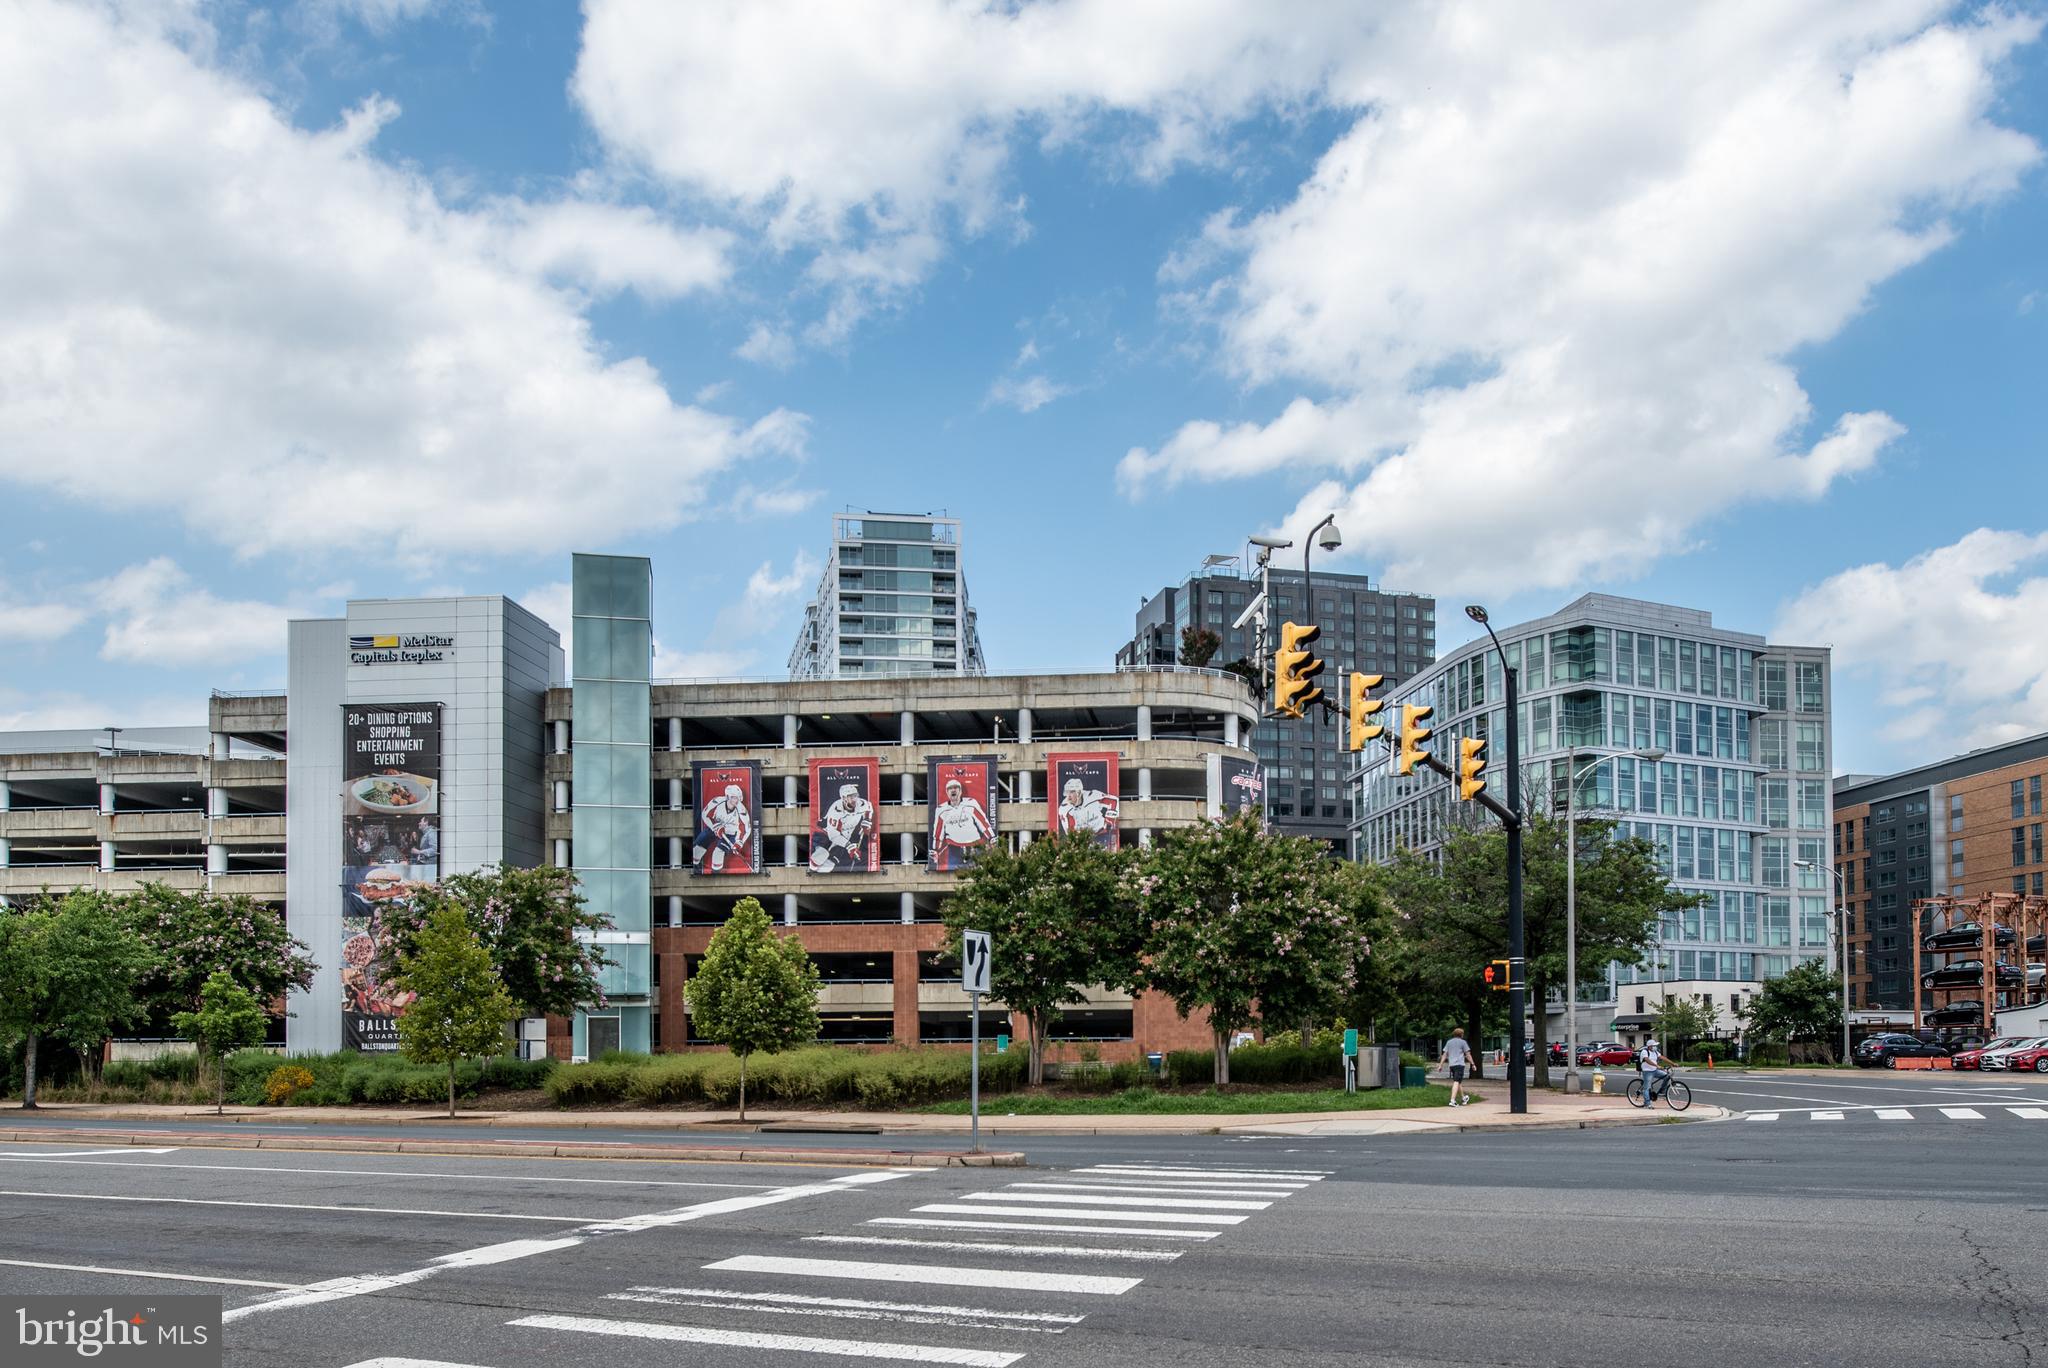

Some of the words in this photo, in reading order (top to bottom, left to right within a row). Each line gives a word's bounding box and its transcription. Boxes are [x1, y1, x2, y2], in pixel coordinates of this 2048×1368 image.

[403, 635, 454, 648] MedStar
[351, 650, 398, 666] Capitals
[400, 649, 442, 664] Iceplex
[348, 713, 365, 726] 20+
[367, 712, 396, 725] DINING
[398, 711, 433, 724] OPTIONS
[369, 726, 411, 738] SHOPPING
[356, 739, 424, 752] ENTERTAINMENT
[374, 753, 406, 765] EVENTS
[358, 1019, 397, 1032] BALLS
